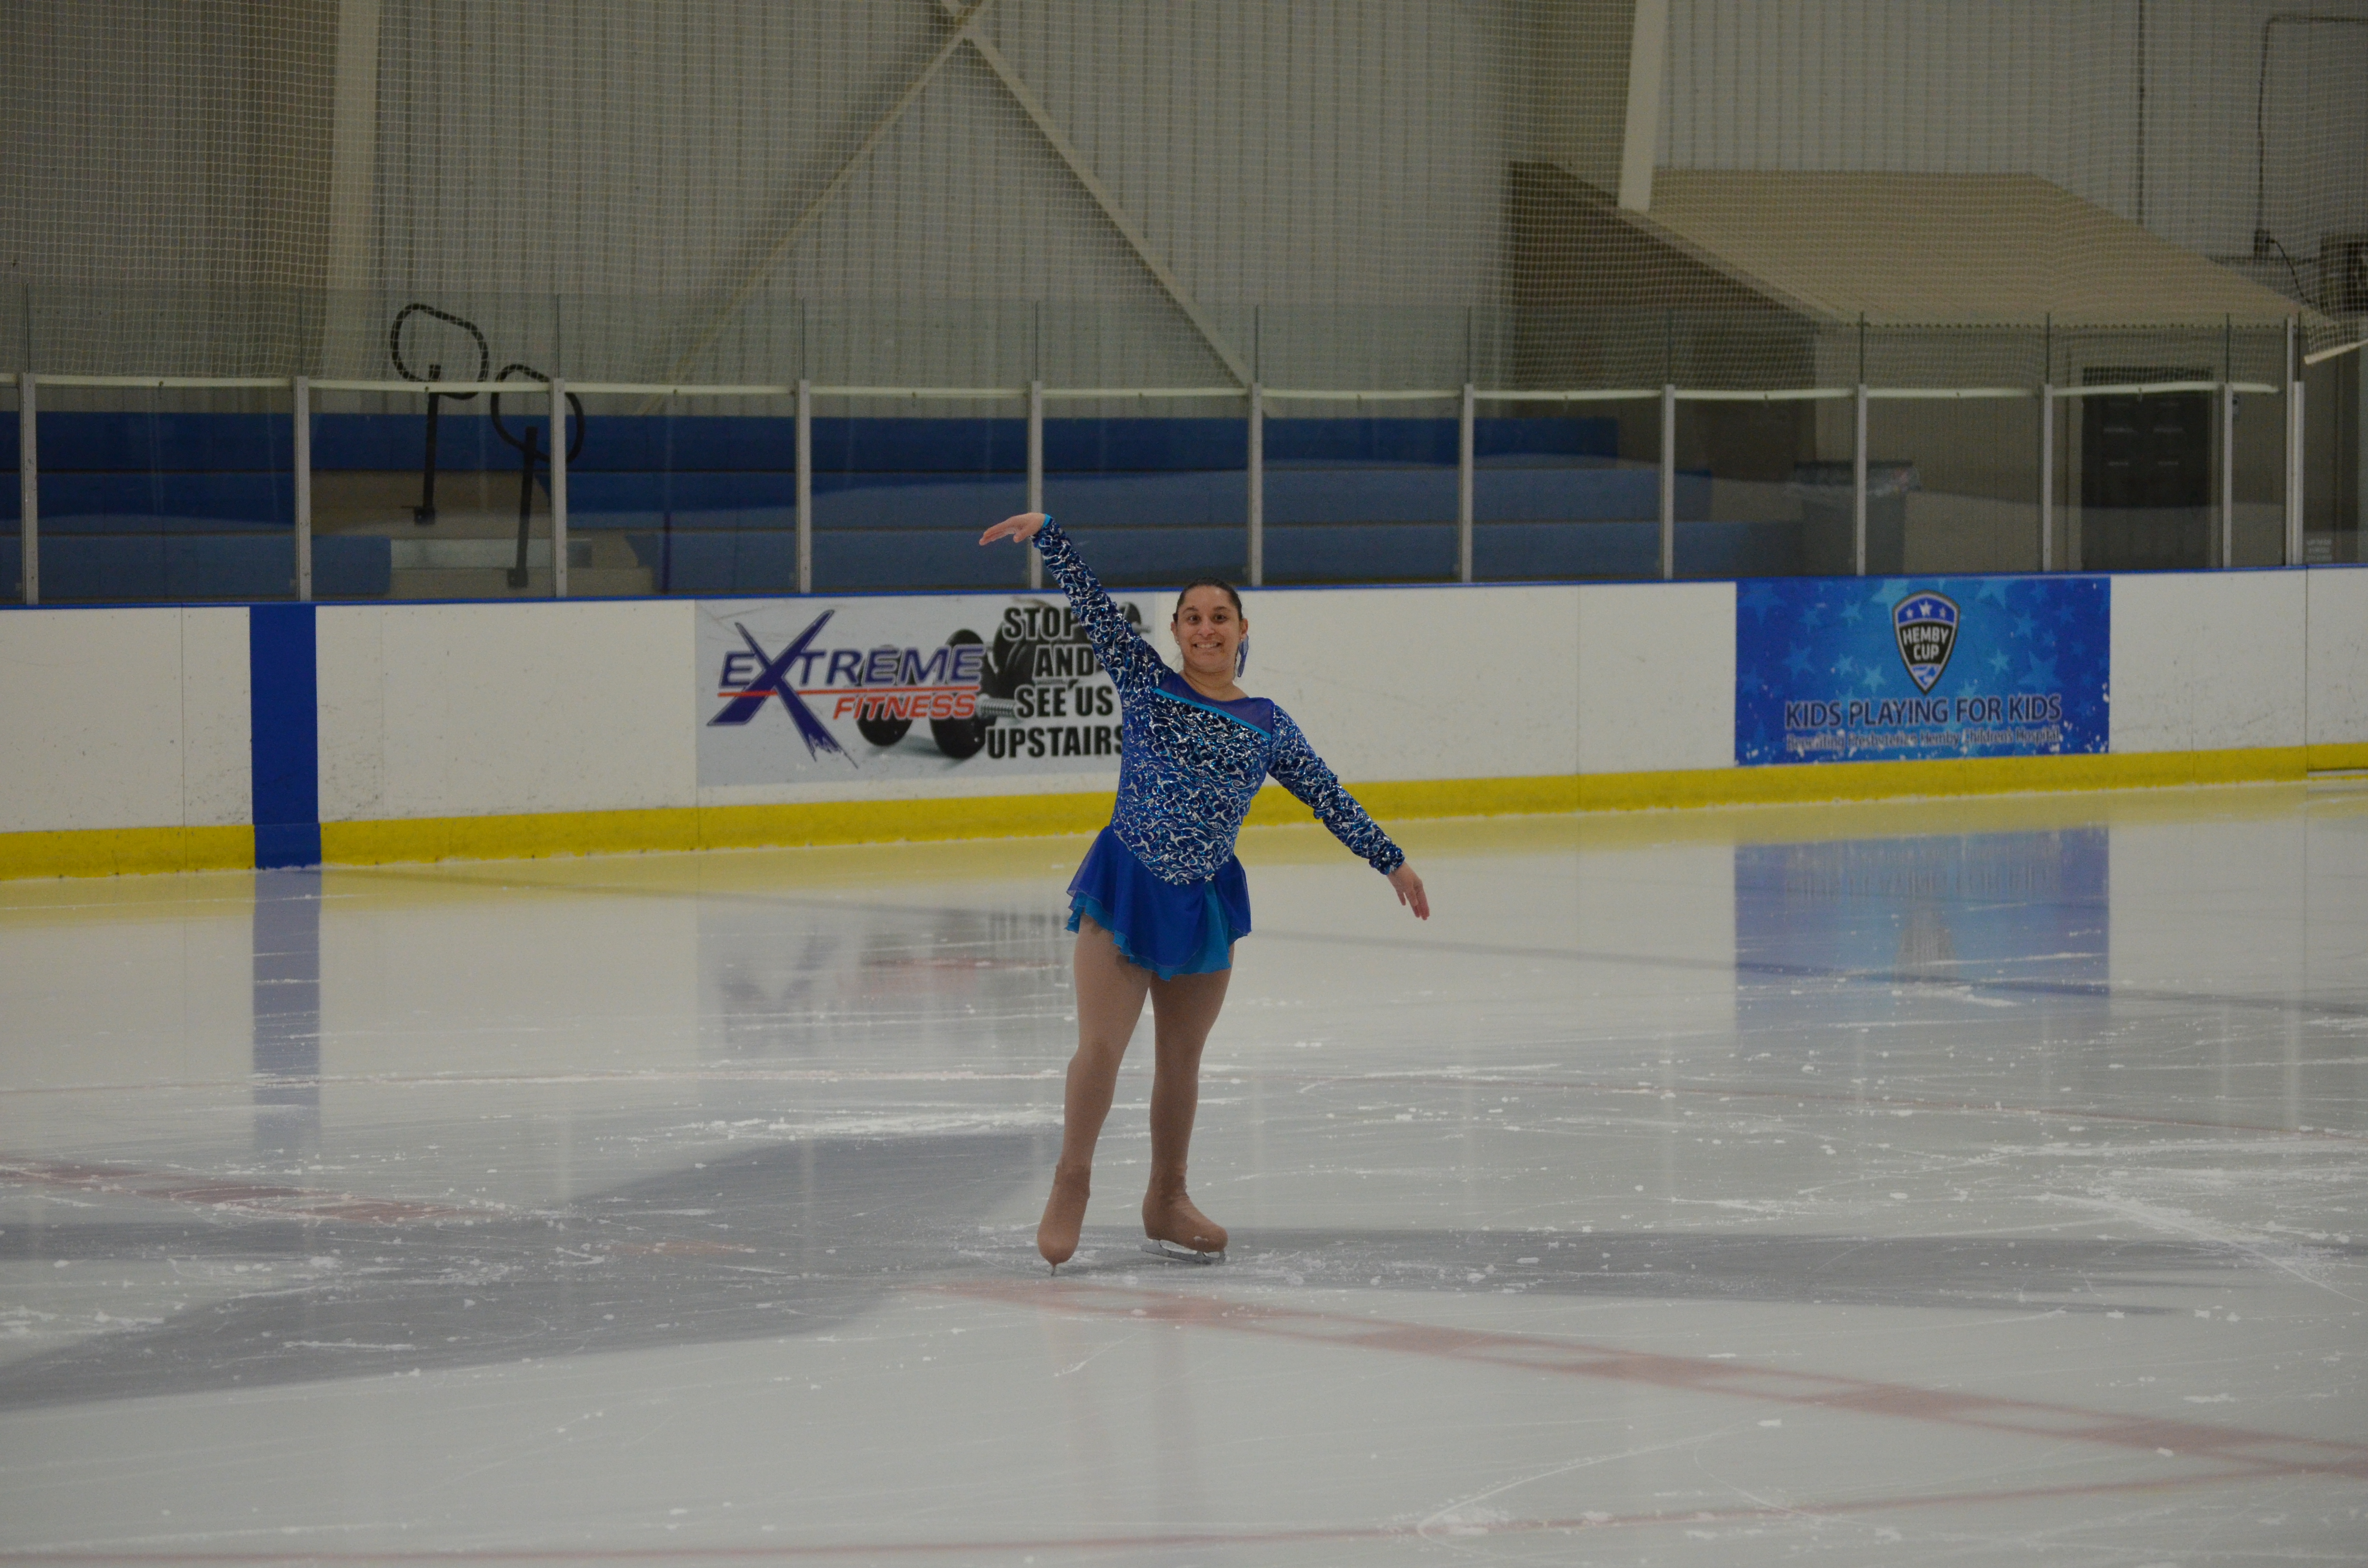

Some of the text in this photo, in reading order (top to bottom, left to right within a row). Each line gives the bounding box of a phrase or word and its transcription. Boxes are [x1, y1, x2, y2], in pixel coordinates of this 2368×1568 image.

[1002, 607, 1079, 640] STOP
[1902, 625, 1949, 646] HEMBY
[1033, 645, 1095, 677] AND
[1913, 643, 1940, 661] CUP
[707, 609, 985, 769] EXTREME
[1014, 685, 1113, 718] SEE US
[833, 694, 977, 720] FITNESS
[1785, 693, 2062, 729] KIDS PLAYING FOR KIDS
